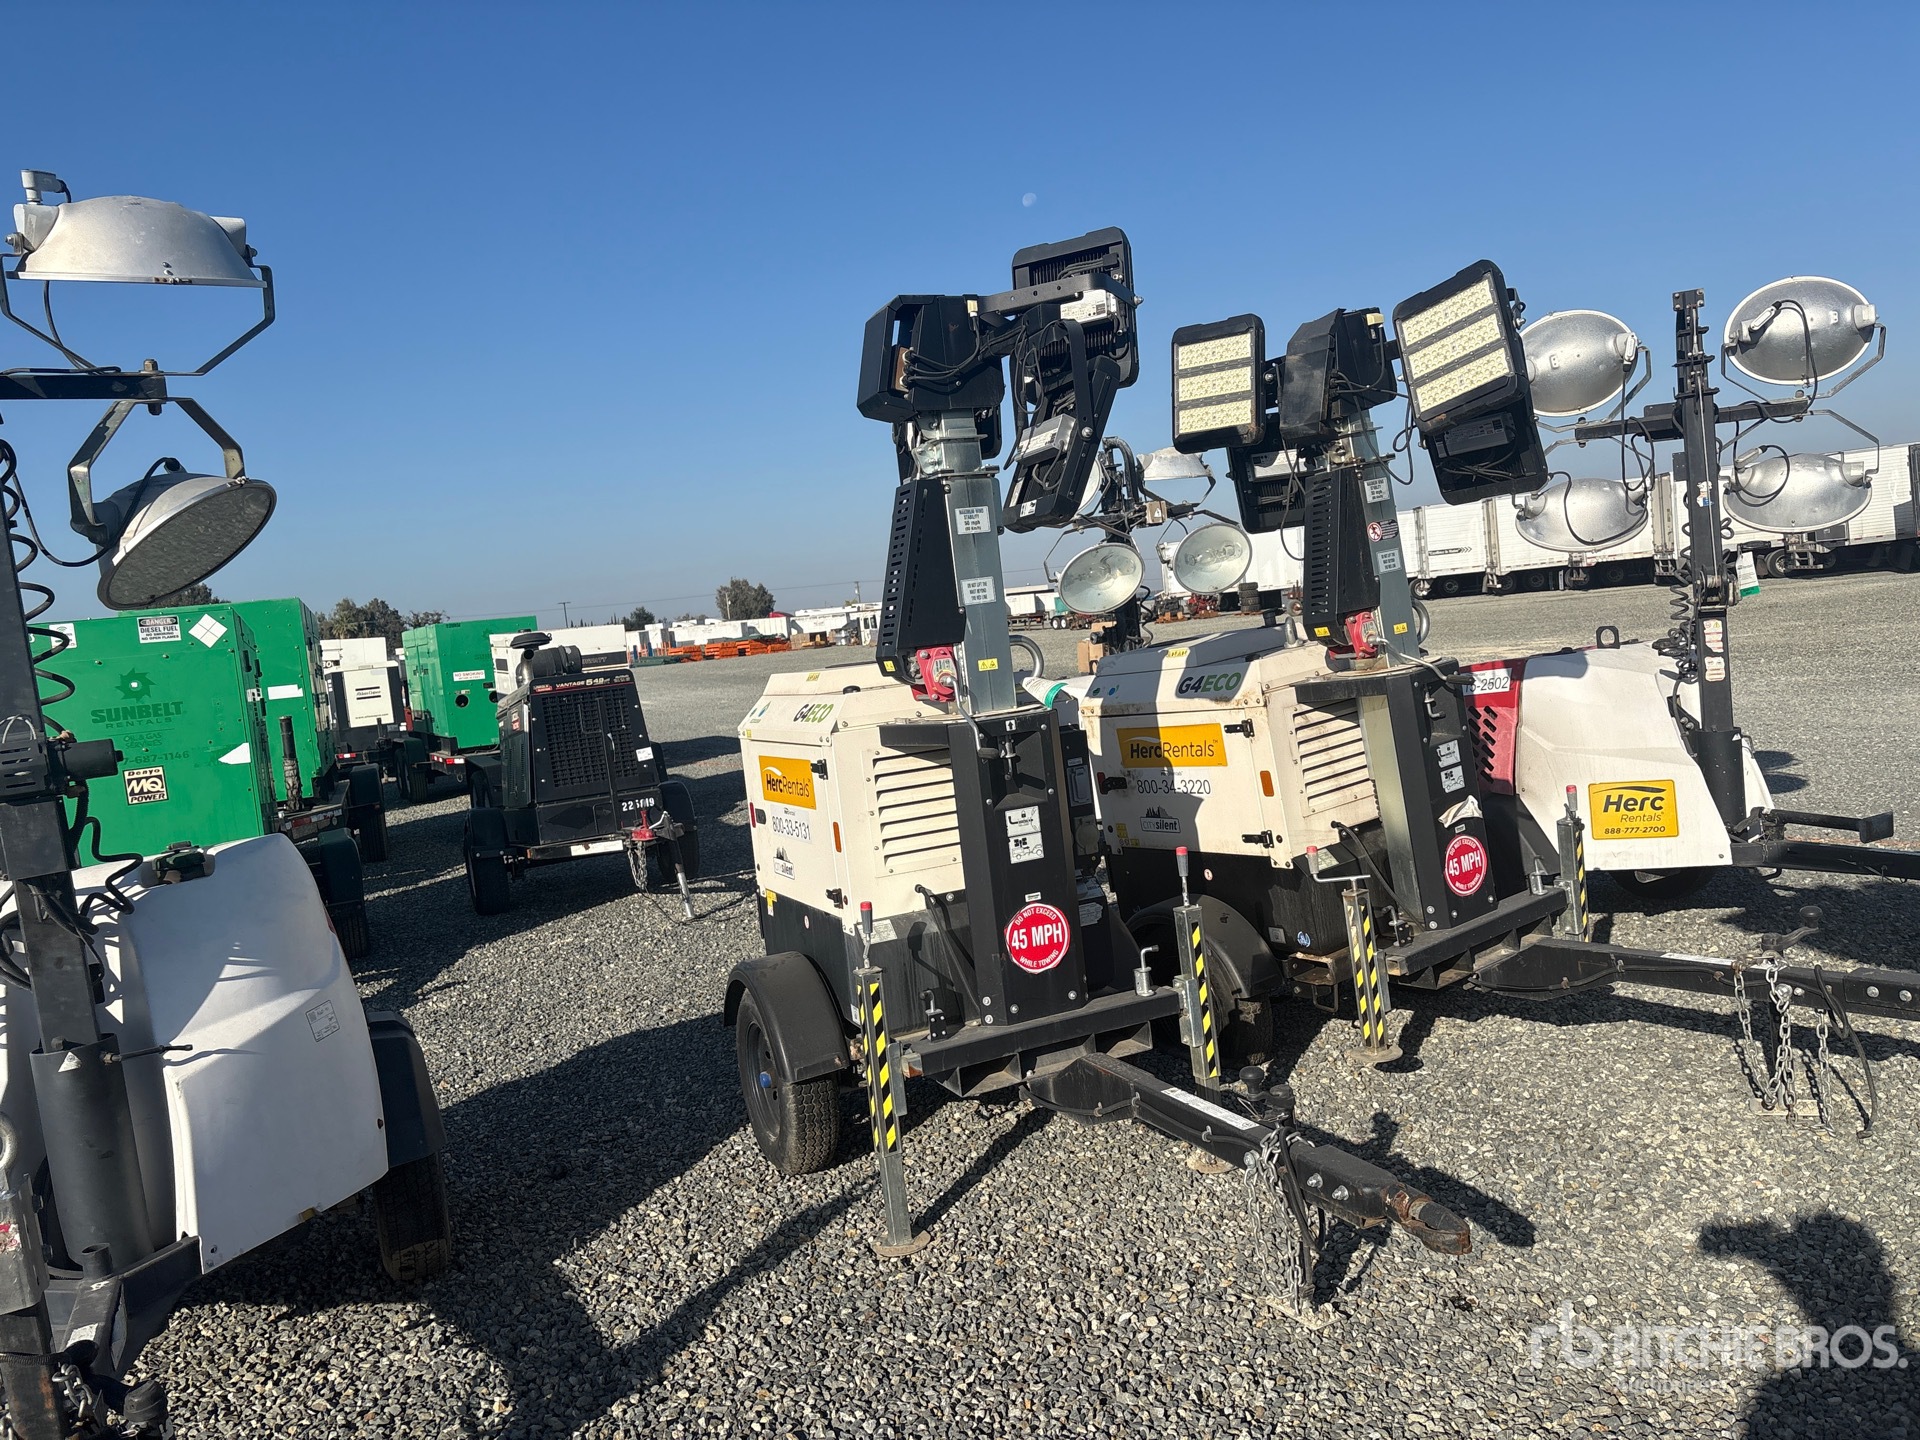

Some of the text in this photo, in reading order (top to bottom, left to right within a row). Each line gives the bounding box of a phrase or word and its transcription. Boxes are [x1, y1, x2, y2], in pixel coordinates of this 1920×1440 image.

[1178, 672, 1241, 694] G4ECO
[91, 702, 183, 723] SUNBELT
[793, 704, 834, 723] G4ECO
[106, 716, 172, 729] RENTALS
[128, 777, 164, 794] MQ
[1137, 780, 1211, 794] 800-34-3220
[130, 793, 165, 803] POWER
[1603, 794, 1665, 813] Herc
[1620, 812, 1662, 822] Rentals
[772, 816, 810, 840] 800-33-5131
[1604, 826, 1665, 834] 888-777-2700
[1462, 839, 1476, 848] EXCEED
[1448, 850, 1482, 876] 45 MPH
[1455, 874, 1480, 890] WHILE TOWING
[1015, 907, 1057, 926] DO NOT EXCEED
[1012, 922, 1062, 950] 45 MPH
[1019, 950, 1059, 968] WHILE TOWING
